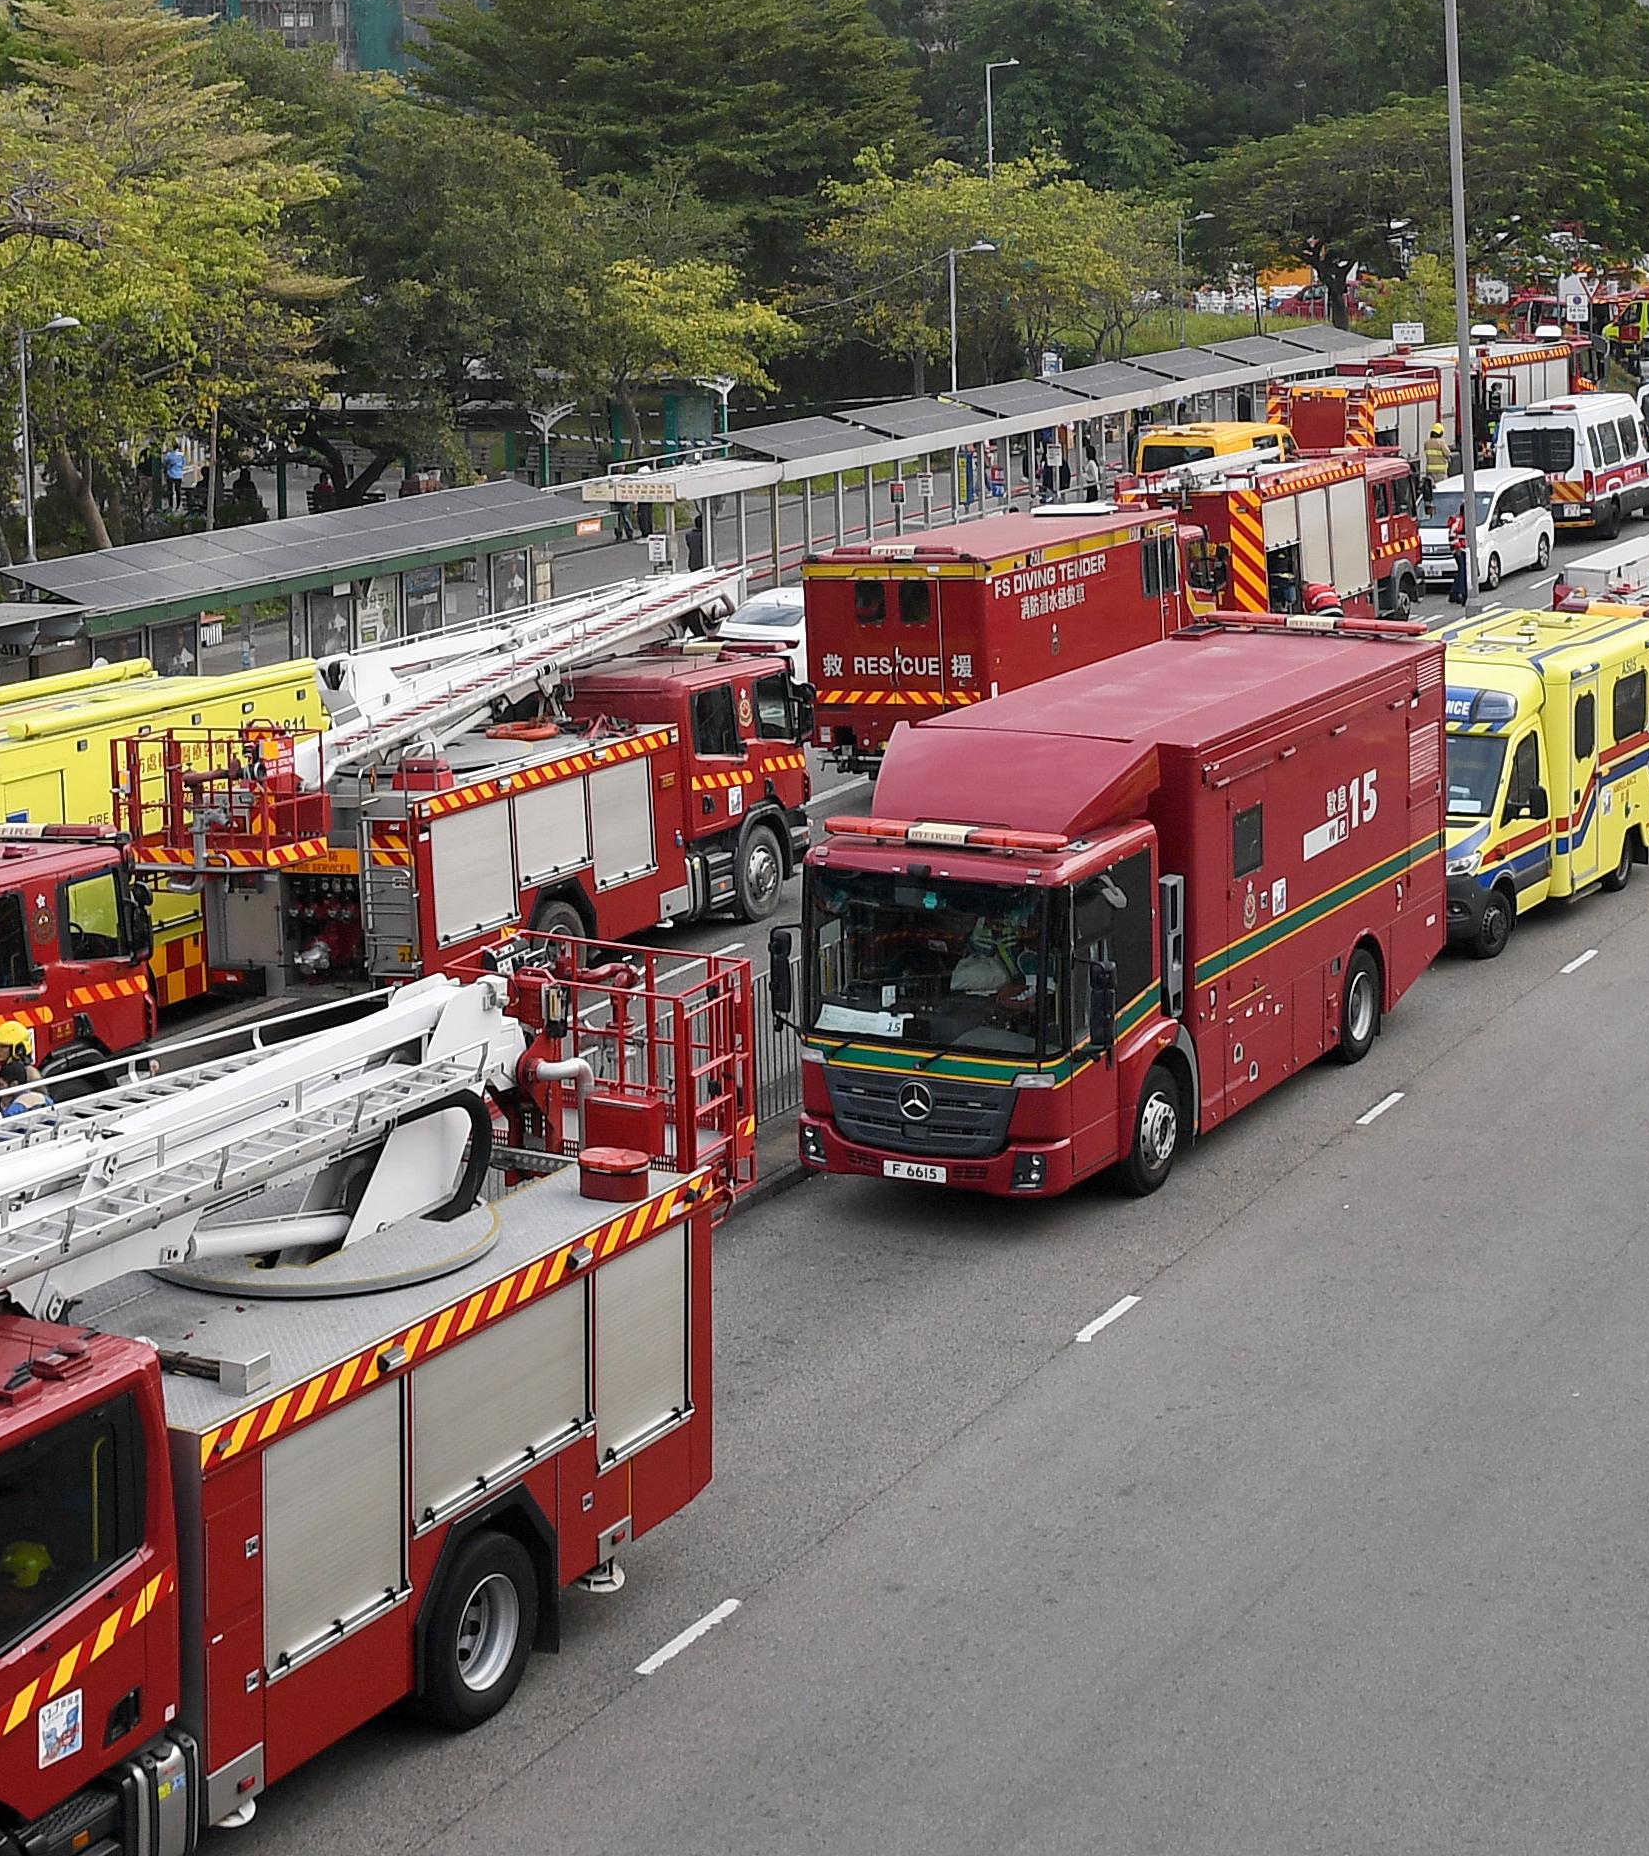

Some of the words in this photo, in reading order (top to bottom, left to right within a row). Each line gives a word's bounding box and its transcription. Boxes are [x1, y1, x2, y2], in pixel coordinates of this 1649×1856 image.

[994, 578, 1011, 600] FS
[1014, 565, 1056, 594] DIVING
[1058, 553, 1107, 581] TENDER
[823, 653, 843, 677] 救
[853, 655, 941, 676] RESCUE
[951, 654, 973, 678] 援
[1349, 768, 1378, 830] 15
[1, 827, 33, 835] FIRE
[892, 1164, 900, 1175] F
[906, 1165, 938, 1180] 6615
